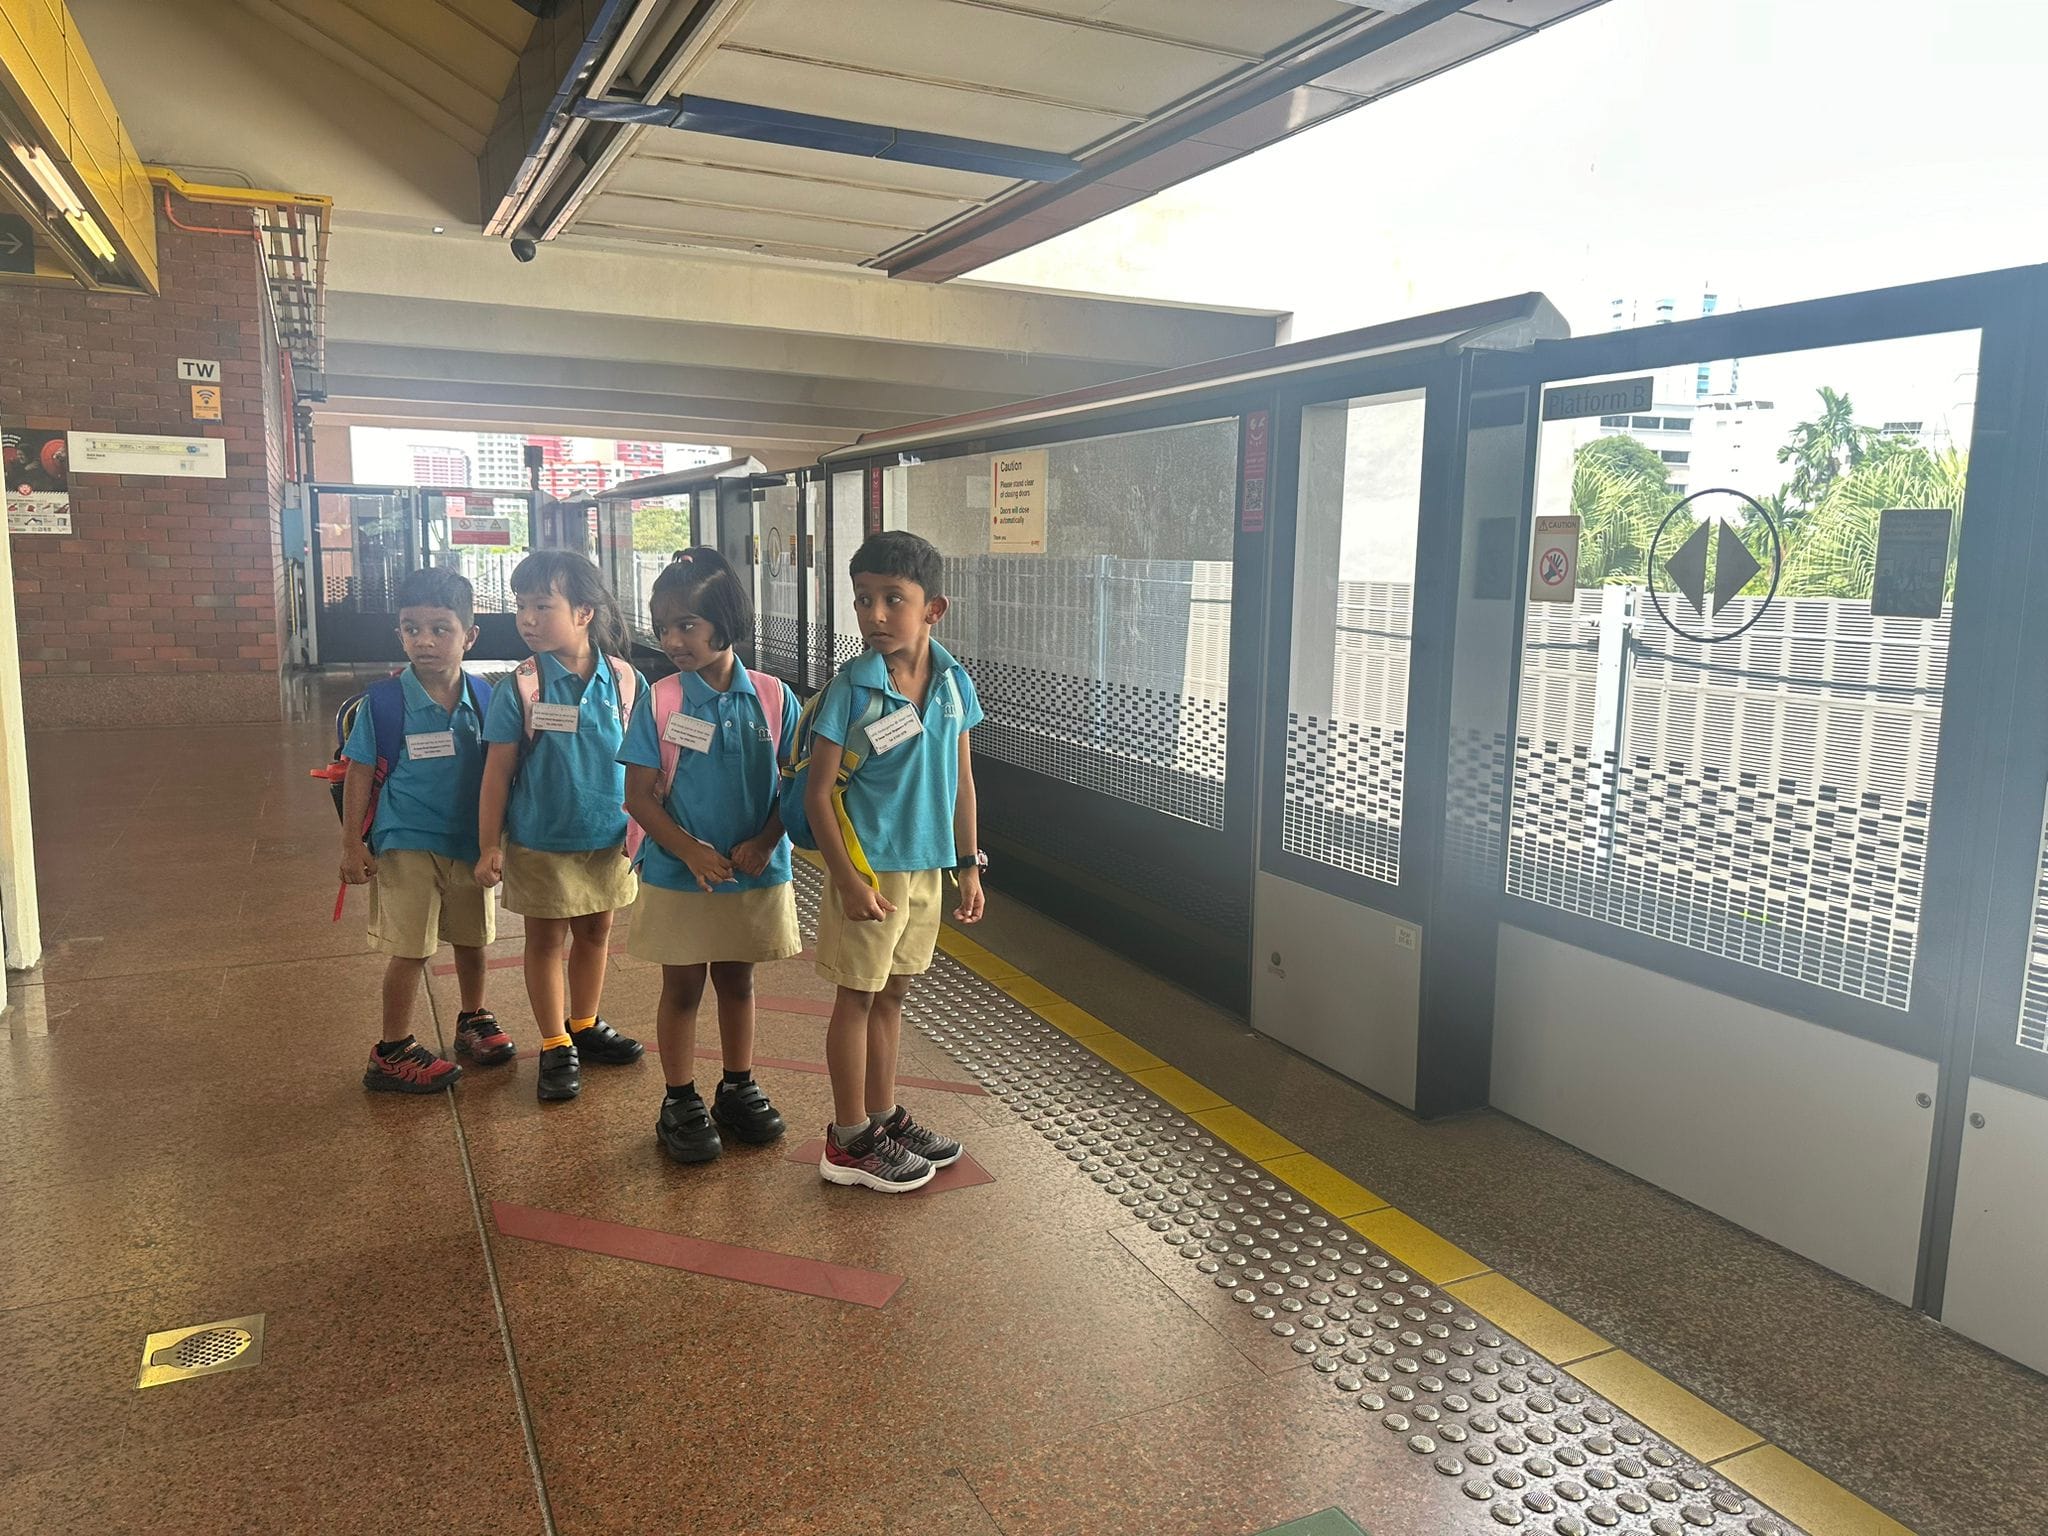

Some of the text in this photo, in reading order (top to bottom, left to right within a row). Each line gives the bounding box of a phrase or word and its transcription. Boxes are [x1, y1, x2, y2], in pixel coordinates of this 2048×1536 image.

[182, 361, 215, 378] TW
[1550, 386, 1645, 416] Platform B
[1000, 461, 1022, 472] Caution
[1548, 521, 1577, 529] CAUTION
